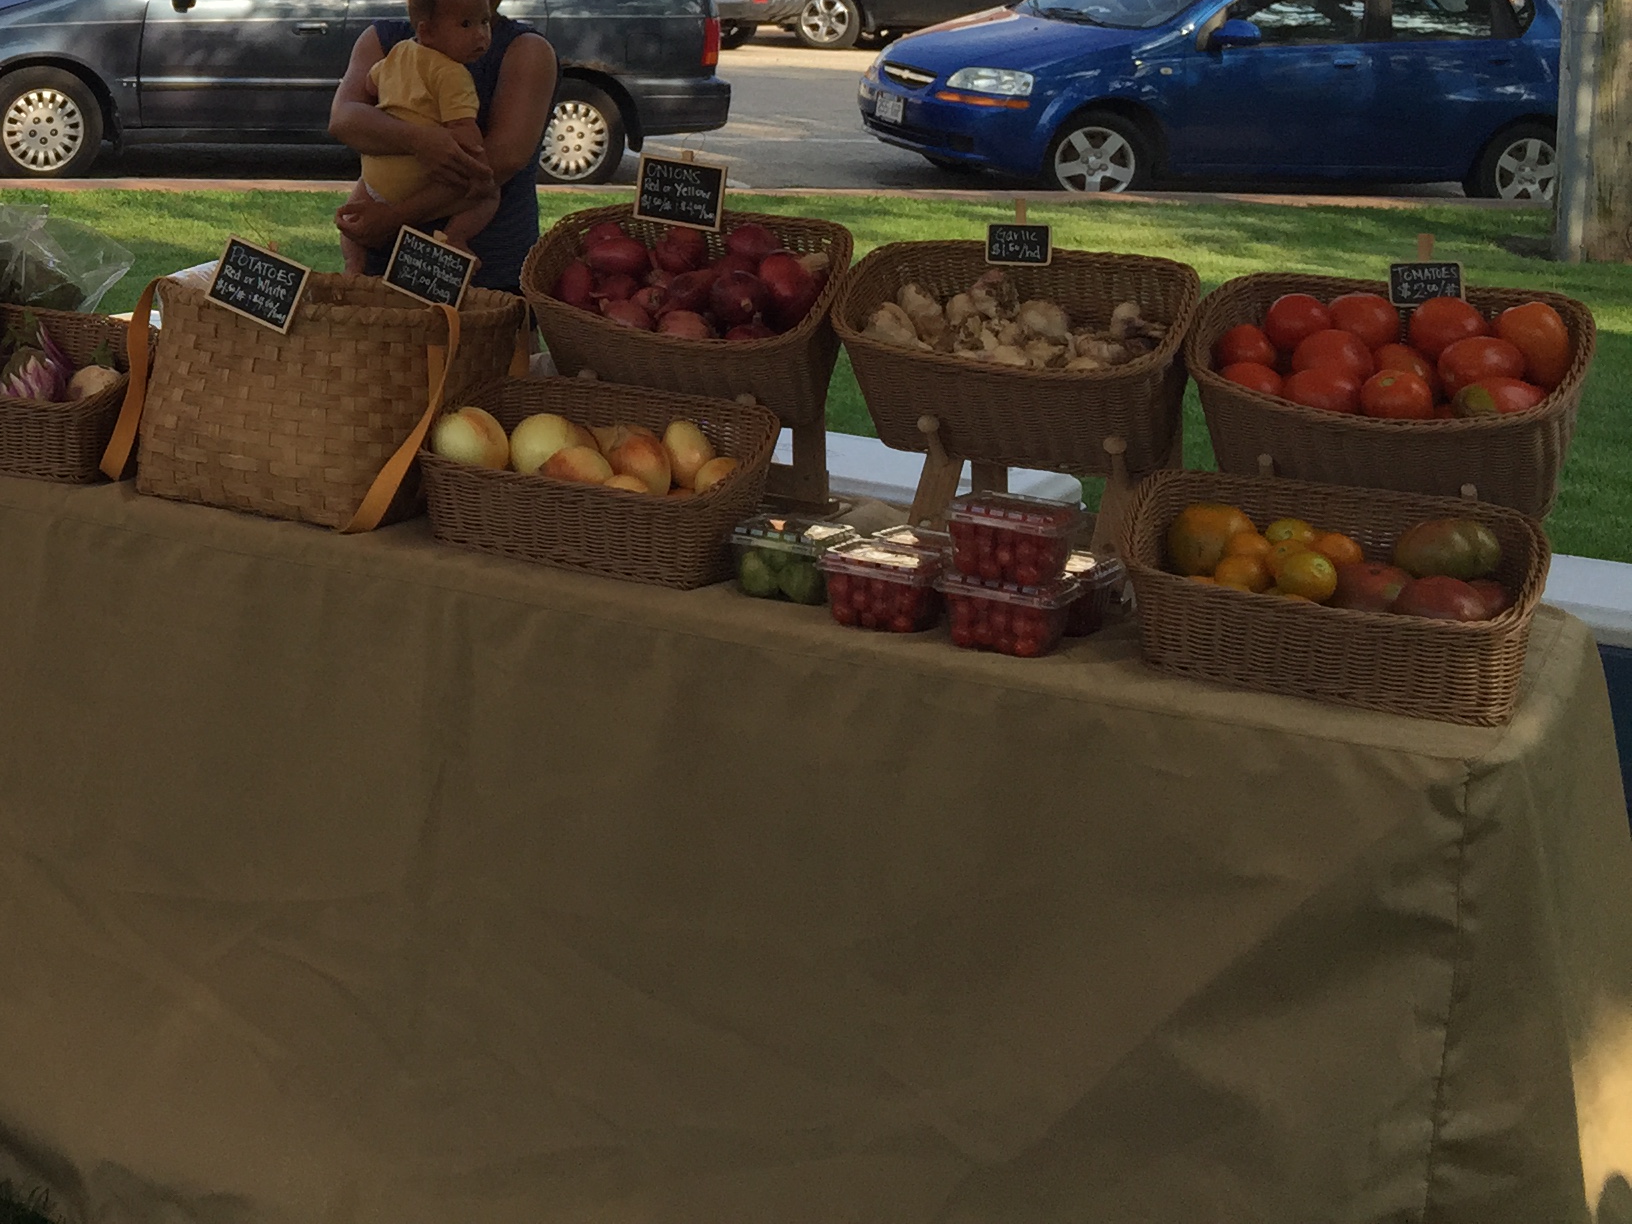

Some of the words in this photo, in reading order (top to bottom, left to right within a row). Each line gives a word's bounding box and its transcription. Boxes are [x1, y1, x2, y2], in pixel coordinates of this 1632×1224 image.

[647, 163, 700, 184] ONIONS
[644, 178, 660, 192] Red
[674, 182, 712, 200] Yellow
[995, 227, 1038, 243] Garlic
[403, 233, 425, 254] Mix
[431, 247, 463, 272] Match
[222, 265, 242, 281] Red
[229, 245, 295, 286] POTATOES
[1392, 266, 1458, 282] TOMATOES
